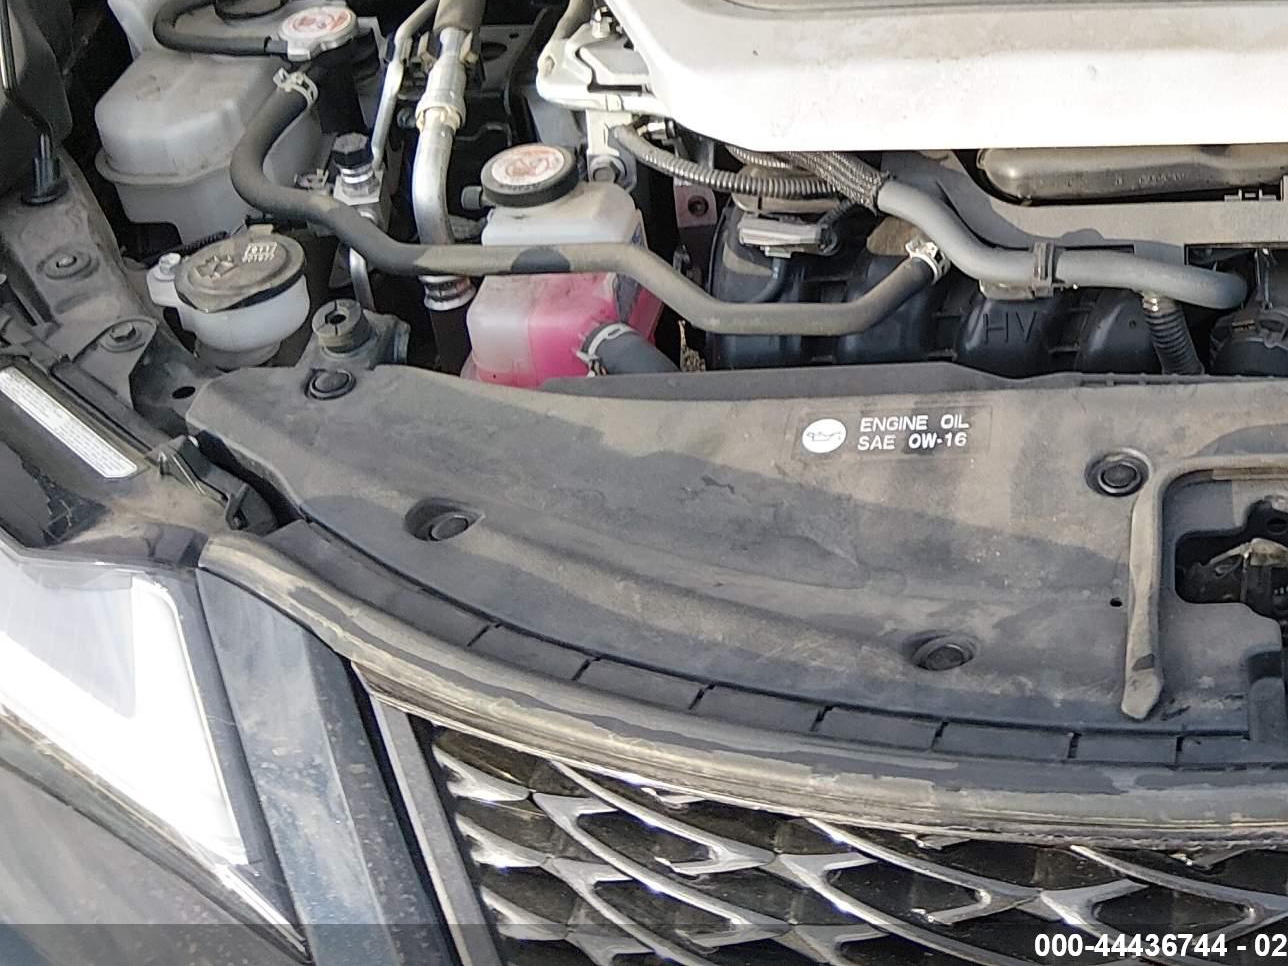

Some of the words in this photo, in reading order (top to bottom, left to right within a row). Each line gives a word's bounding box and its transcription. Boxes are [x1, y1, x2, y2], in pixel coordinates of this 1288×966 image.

[984, 310, 1038, 345] HV
[859, 415, 929, 432] ENGINE
[940, 413, 970, 430] OIL
[856, 434, 897, 451] SAE
[908, 431, 968, 450] 0W-16
